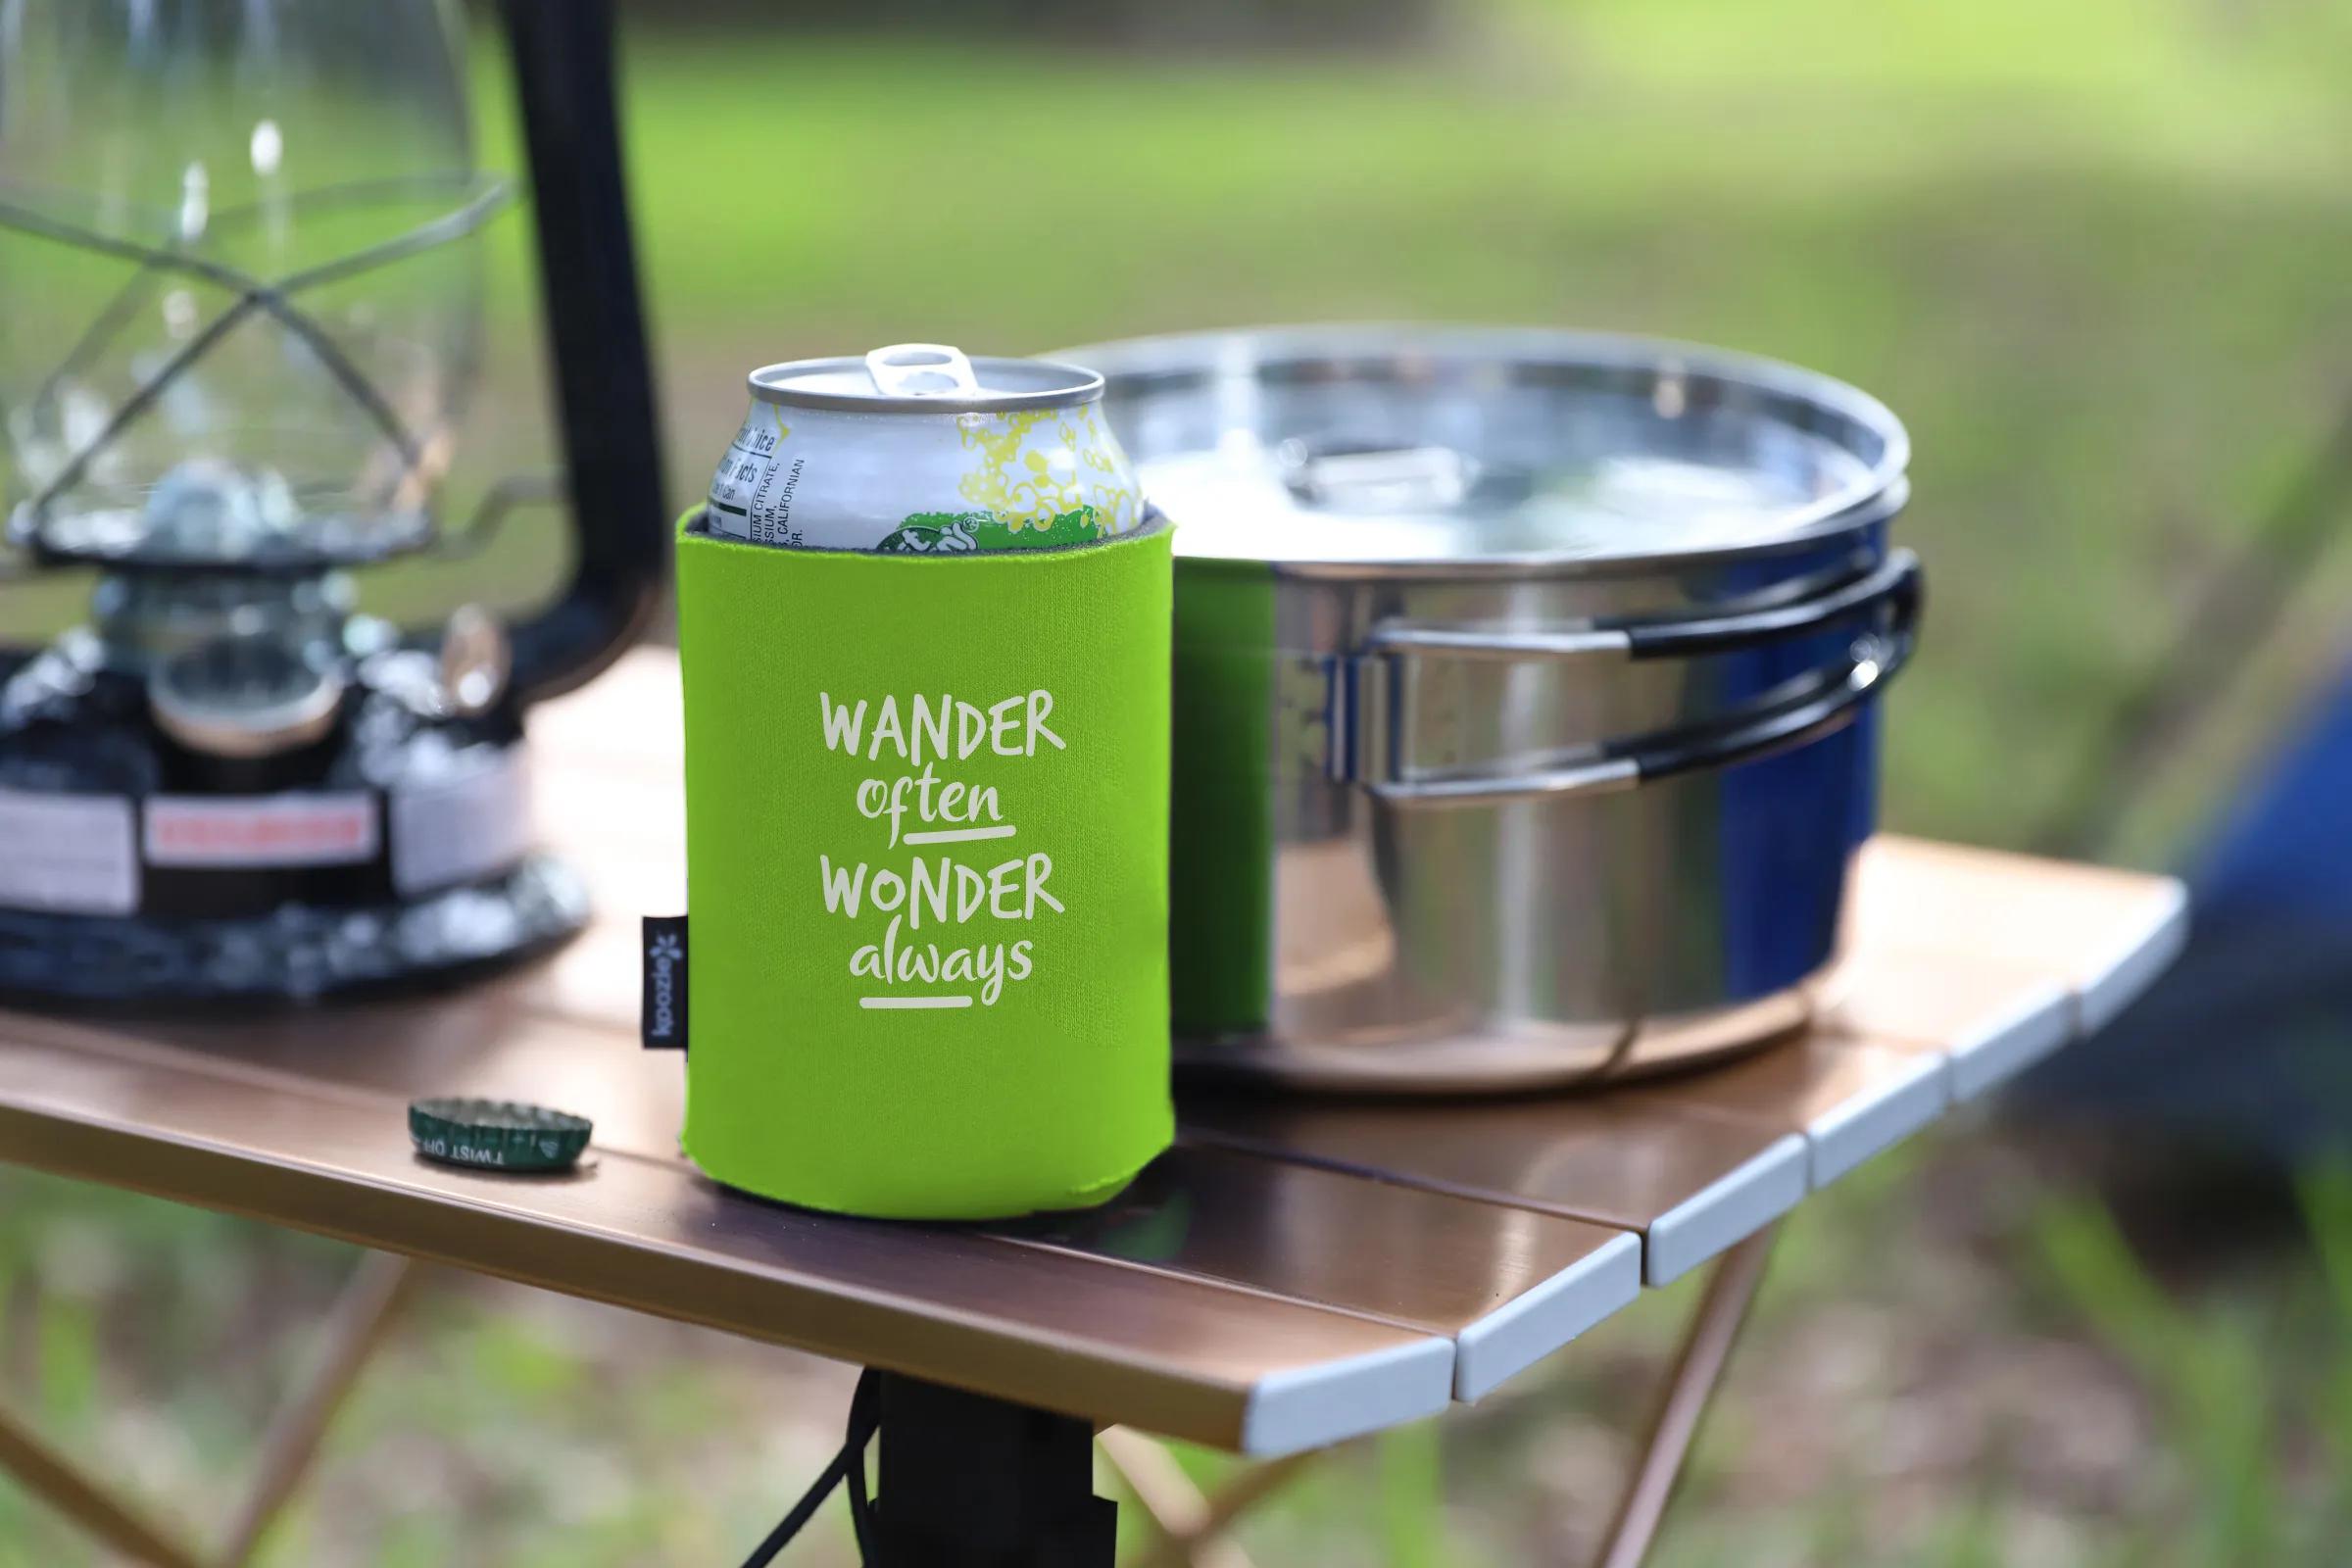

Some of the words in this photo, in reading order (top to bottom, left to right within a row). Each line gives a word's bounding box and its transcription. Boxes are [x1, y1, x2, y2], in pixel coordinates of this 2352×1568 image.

[777, 459, 805, 535] CALIFORNIAN
[820, 689, 1066, 766] WANDER
[857, 760, 1004, 850] often
[819, 853, 1065, 930] WONDER
[651, 956, 674, 1036] koozie
[849, 913, 1033, 1005] always
[450, 1143, 505, 1165] TWIST
